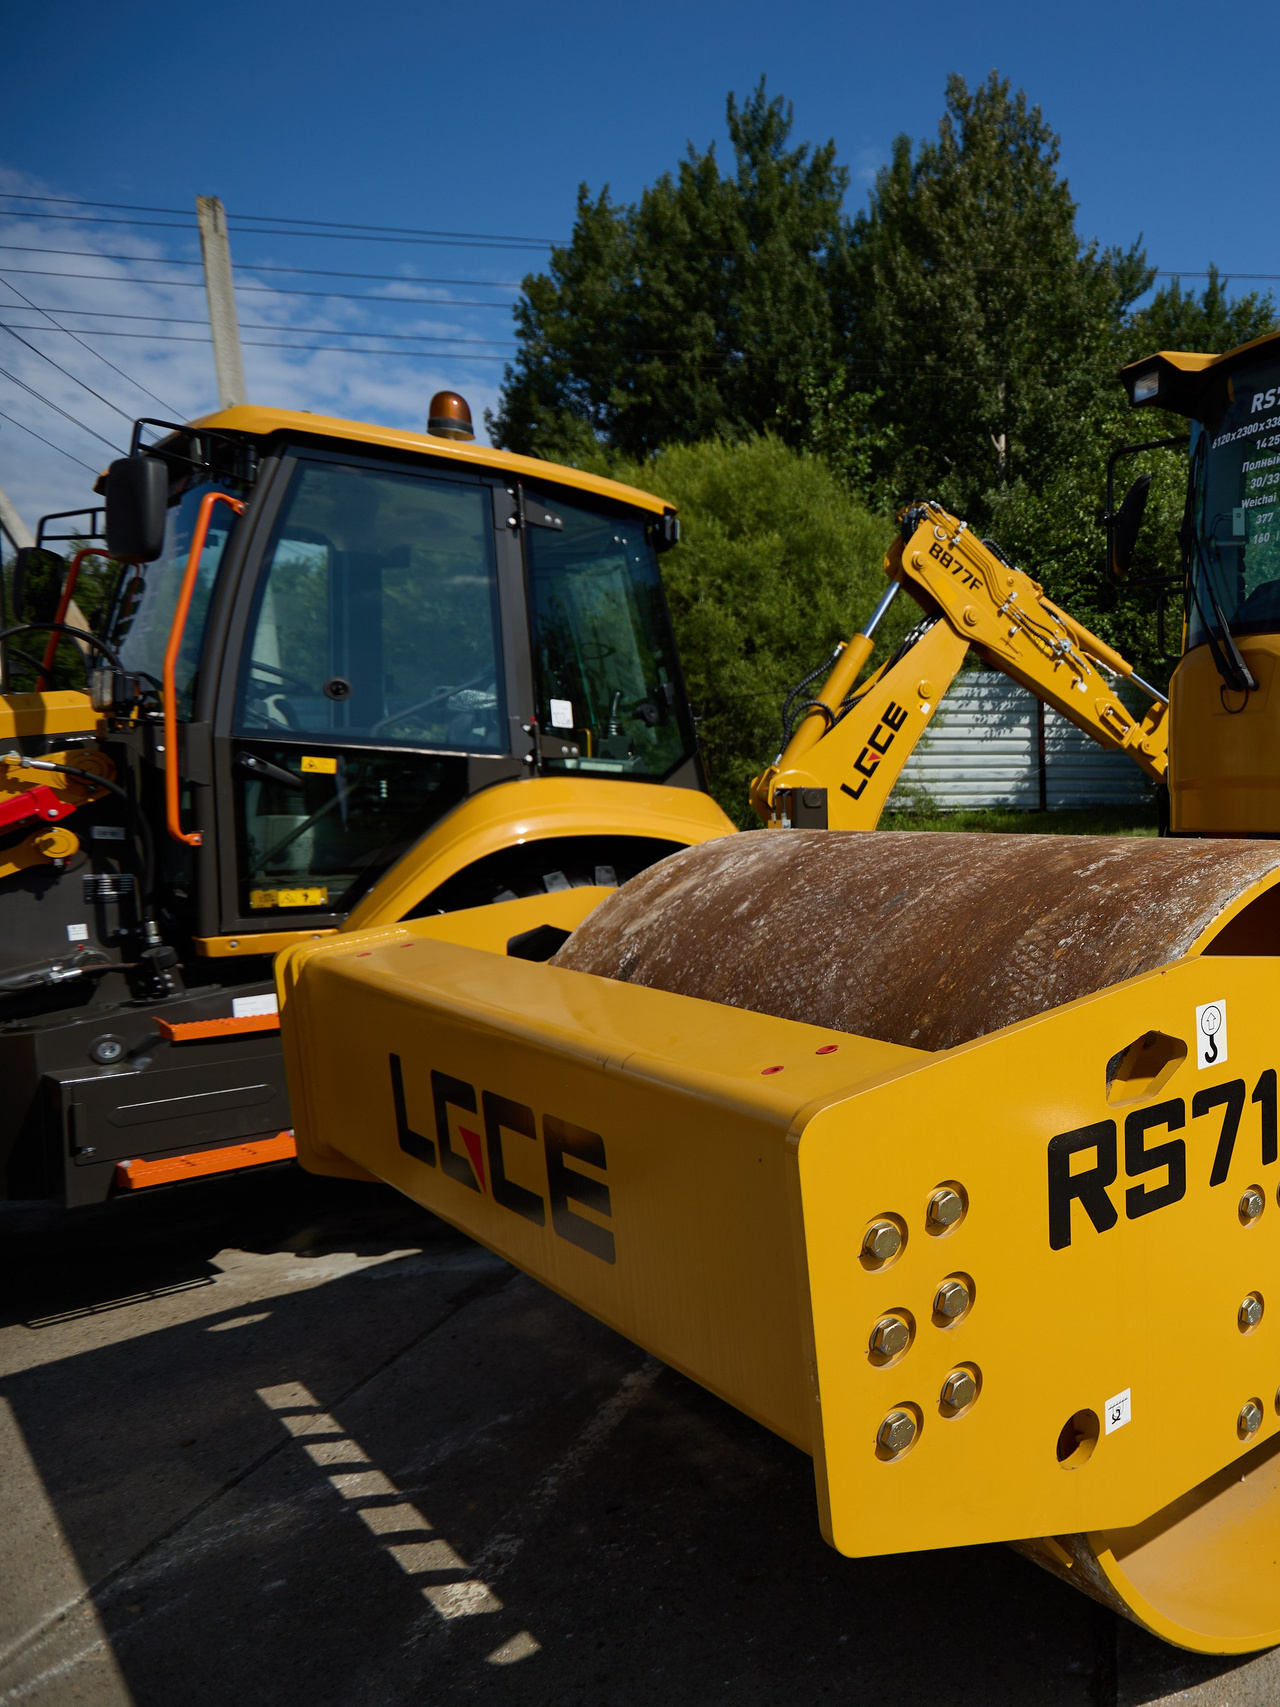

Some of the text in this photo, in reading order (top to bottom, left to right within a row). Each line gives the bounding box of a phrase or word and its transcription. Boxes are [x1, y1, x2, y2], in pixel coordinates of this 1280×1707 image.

[1250, 472, 1280, 489] 30/33
[1241, 491, 1277, 509] Weichai
[1256, 512, 1274, 525] 377
[1253, 532, 1271, 544] 160
